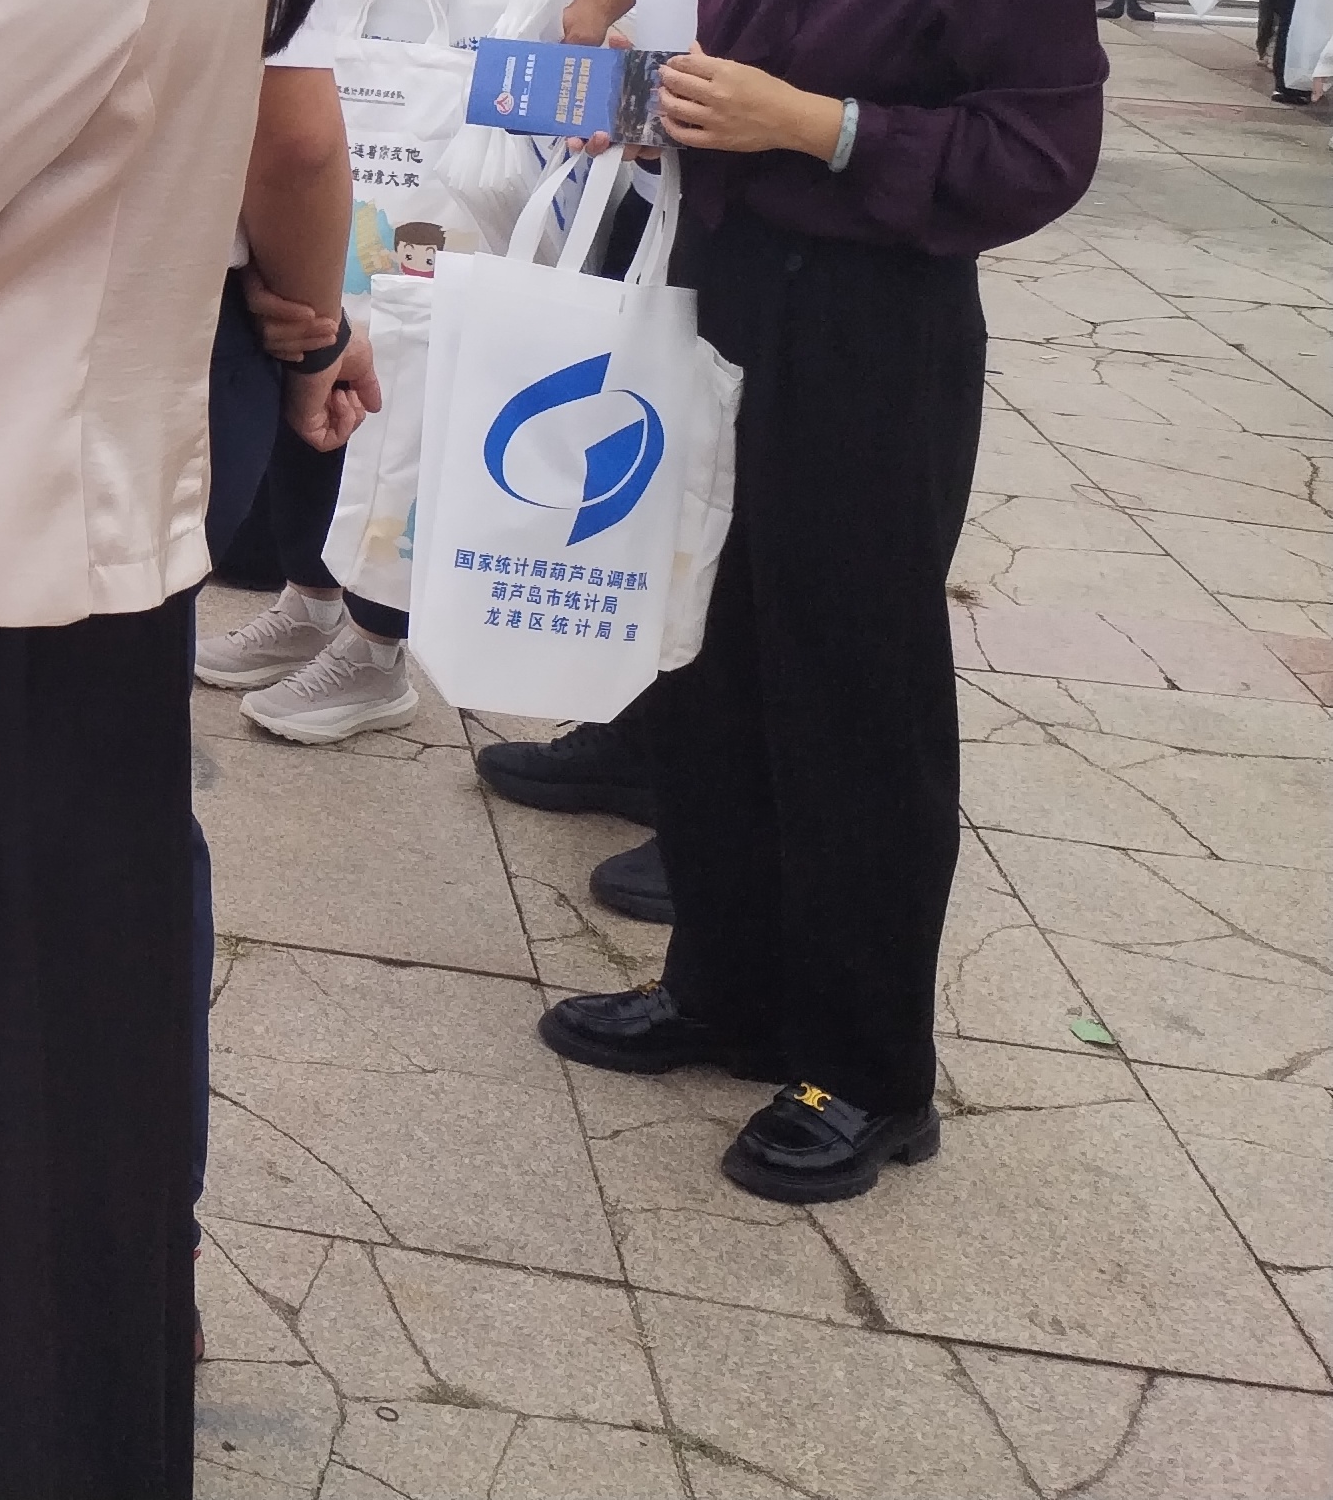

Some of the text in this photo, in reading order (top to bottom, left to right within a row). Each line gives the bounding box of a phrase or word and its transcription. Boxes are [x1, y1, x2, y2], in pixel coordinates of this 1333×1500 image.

[348, 143, 424, 164] 连着你我他
[454, 548, 648, 591] 国家统计局葫芦岛调查队
[491, 580, 619, 614] 葫芦岛市统计局
[484, 606, 639, 641] 龙港区统计局 宣
